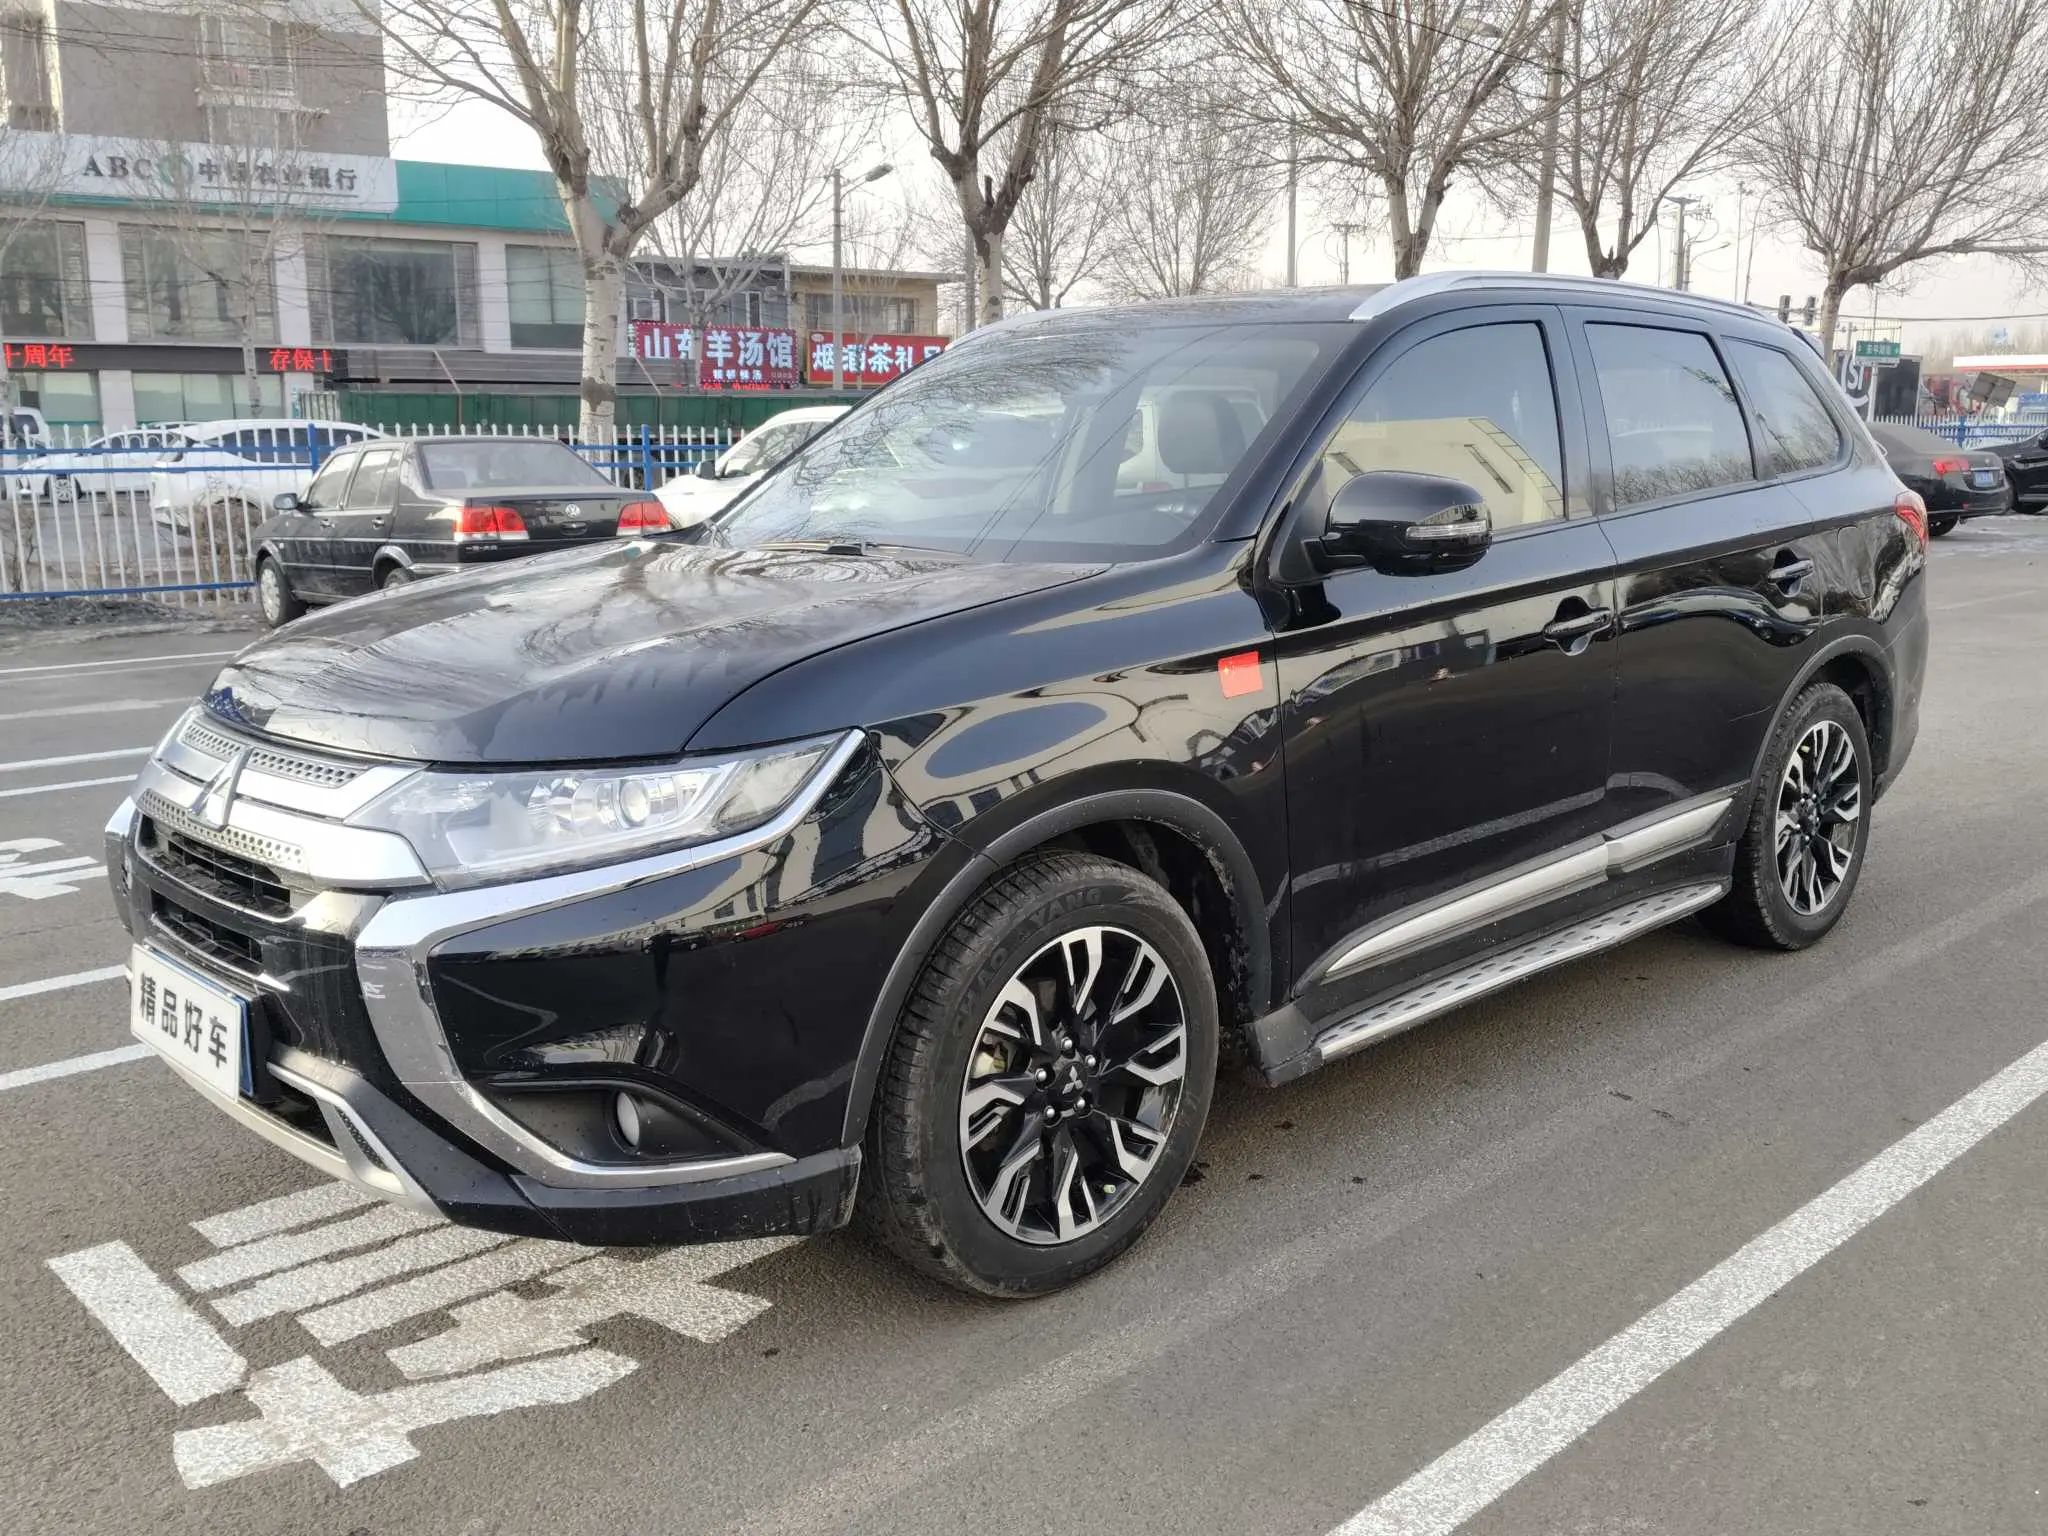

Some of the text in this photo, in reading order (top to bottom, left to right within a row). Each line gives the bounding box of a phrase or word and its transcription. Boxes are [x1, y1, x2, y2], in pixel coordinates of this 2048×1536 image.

[83, 155, 152, 180] ABC
[199, 158, 358, 191] 中国农业银行
[1029, 887, 1102, 926] YANG
[140, 973, 228, 1068] 精品好车
